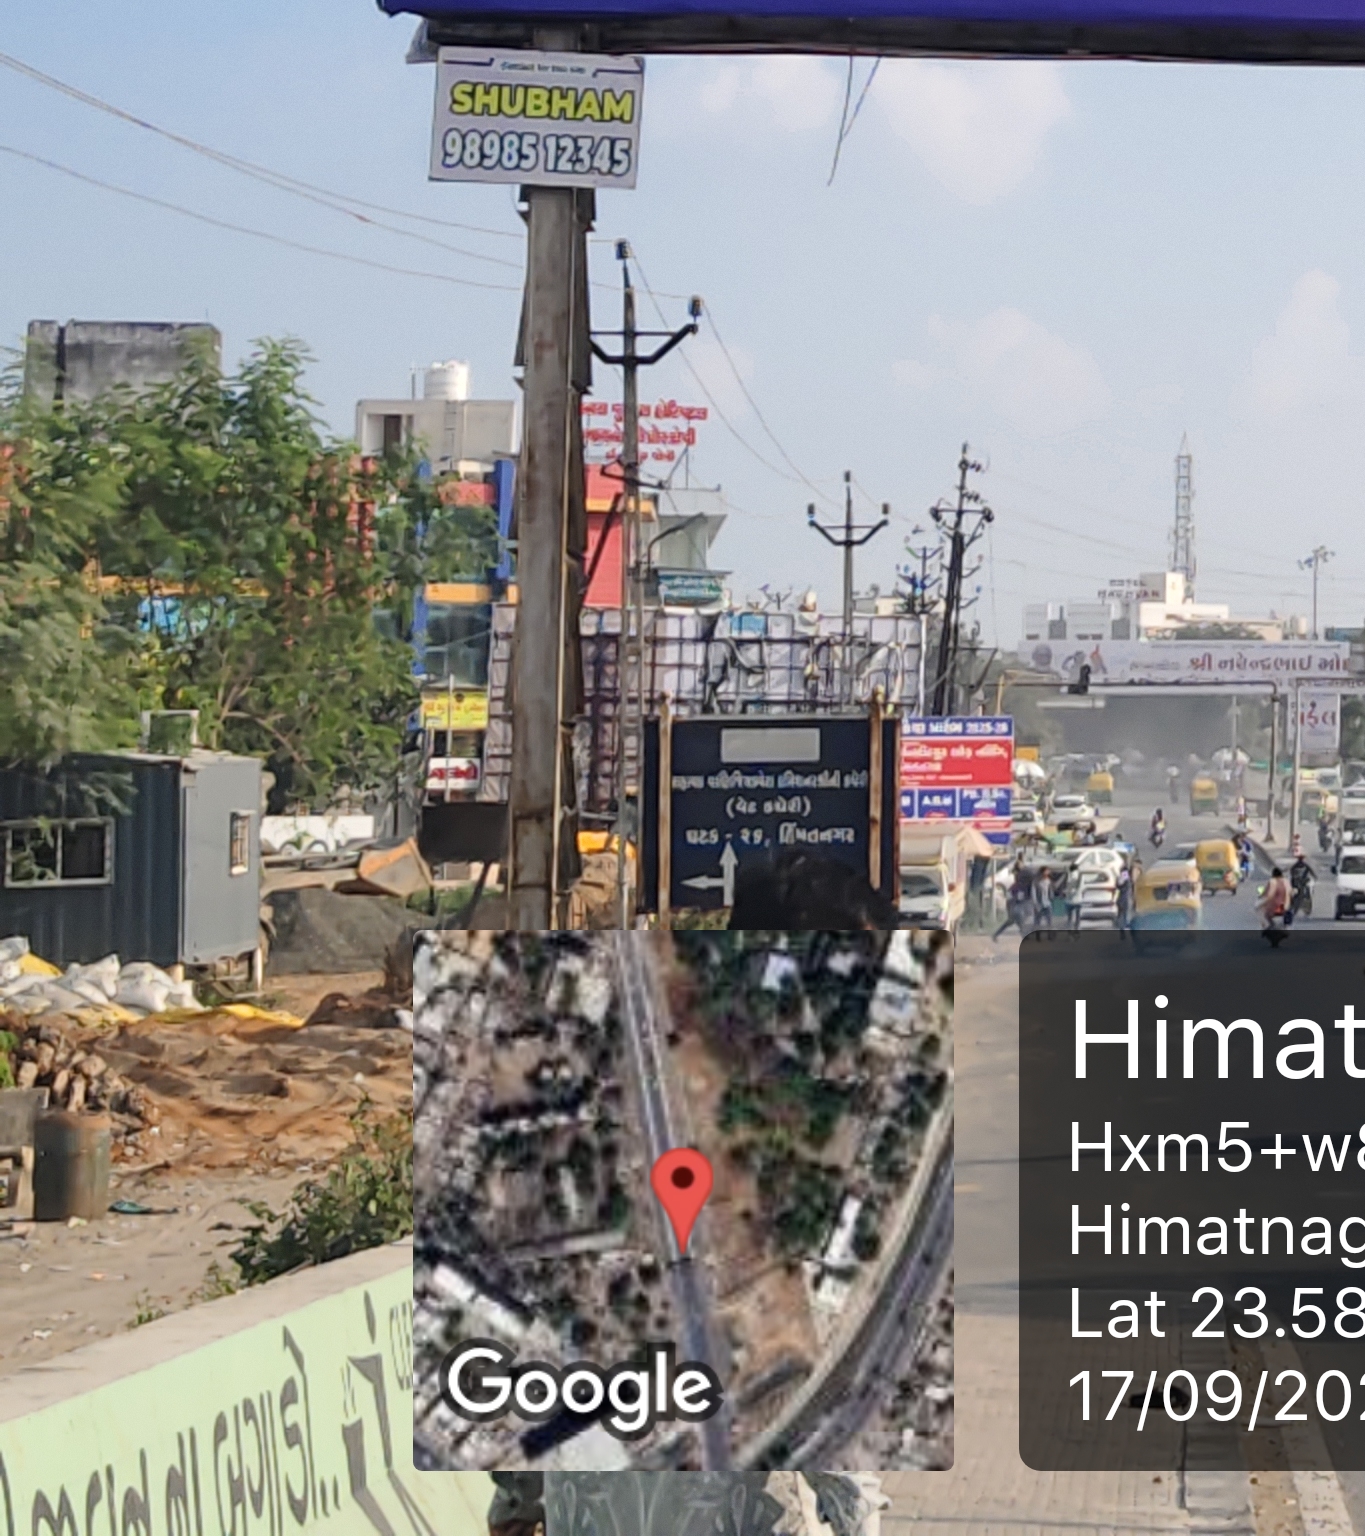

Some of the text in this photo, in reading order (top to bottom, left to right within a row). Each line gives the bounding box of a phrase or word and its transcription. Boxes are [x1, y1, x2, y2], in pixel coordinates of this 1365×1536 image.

[450, 80, 634, 124] SHUBHAM
[442, 128, 632, 177] 98985 12345
